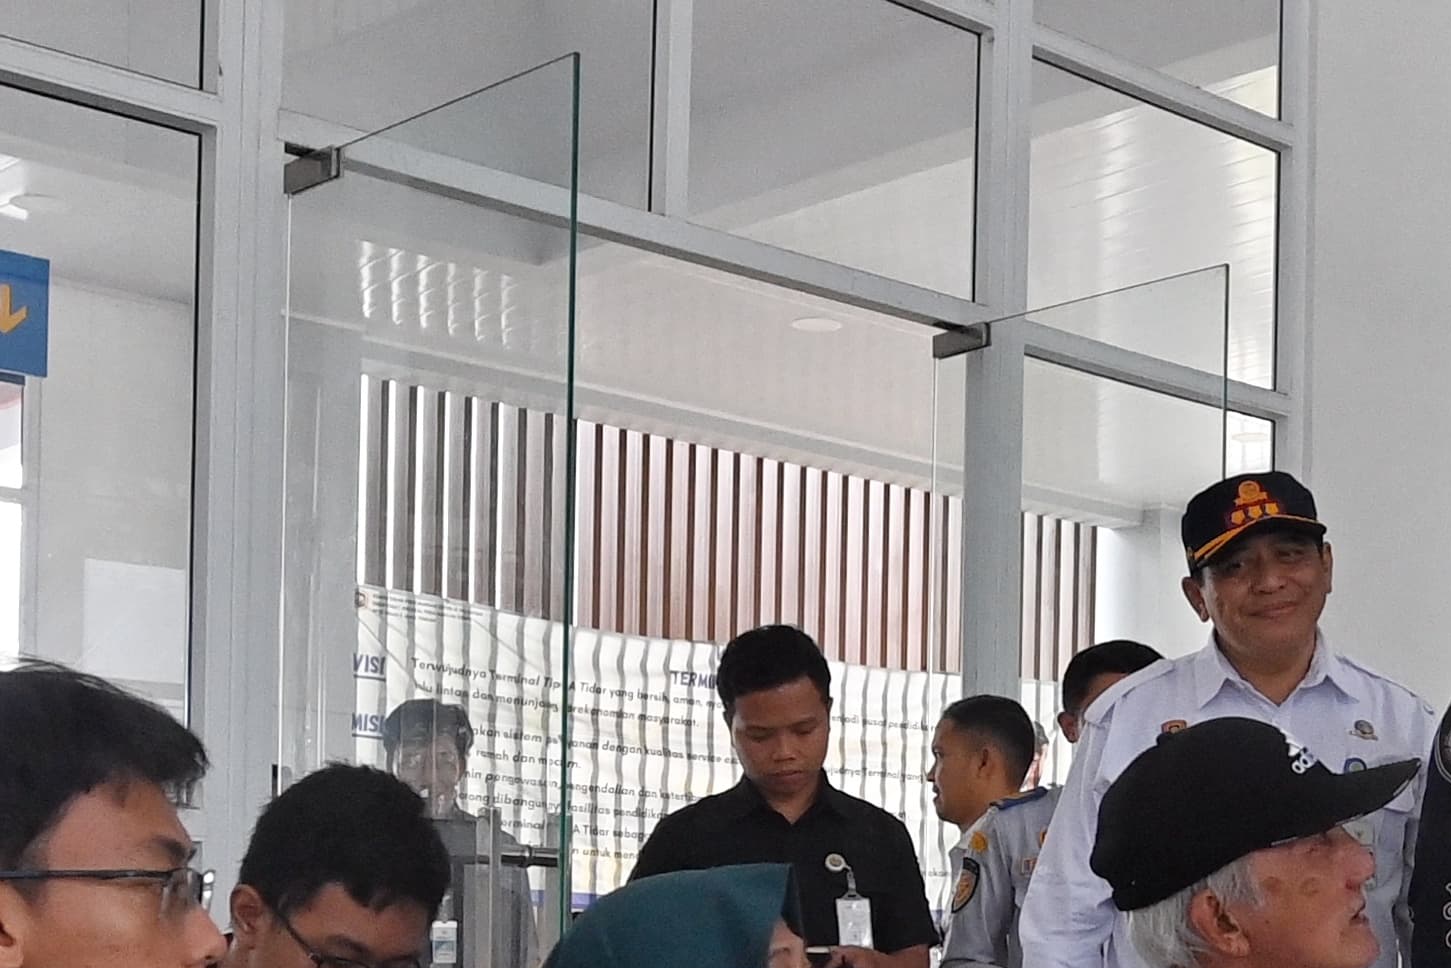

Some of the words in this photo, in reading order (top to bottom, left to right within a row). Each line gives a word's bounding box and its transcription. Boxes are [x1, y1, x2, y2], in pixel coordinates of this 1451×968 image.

[353, 653, 386, 676] VISI
[411, 656, 487, 680] Terwujudnya
[489, 669, 540, 687] Terminal
[544, 676, 564, 690] Tip
[580, 682, 606, 695] Tidar
[609, 688, 633, 701] yang
[567, 702, 635, 721] erekonomian
[602, 740, 641, 756] dengan
[513, 750, 535, 764] dan
[566, 783, 635, 798] engendalian
[500, 819, 546, 832] erminal
